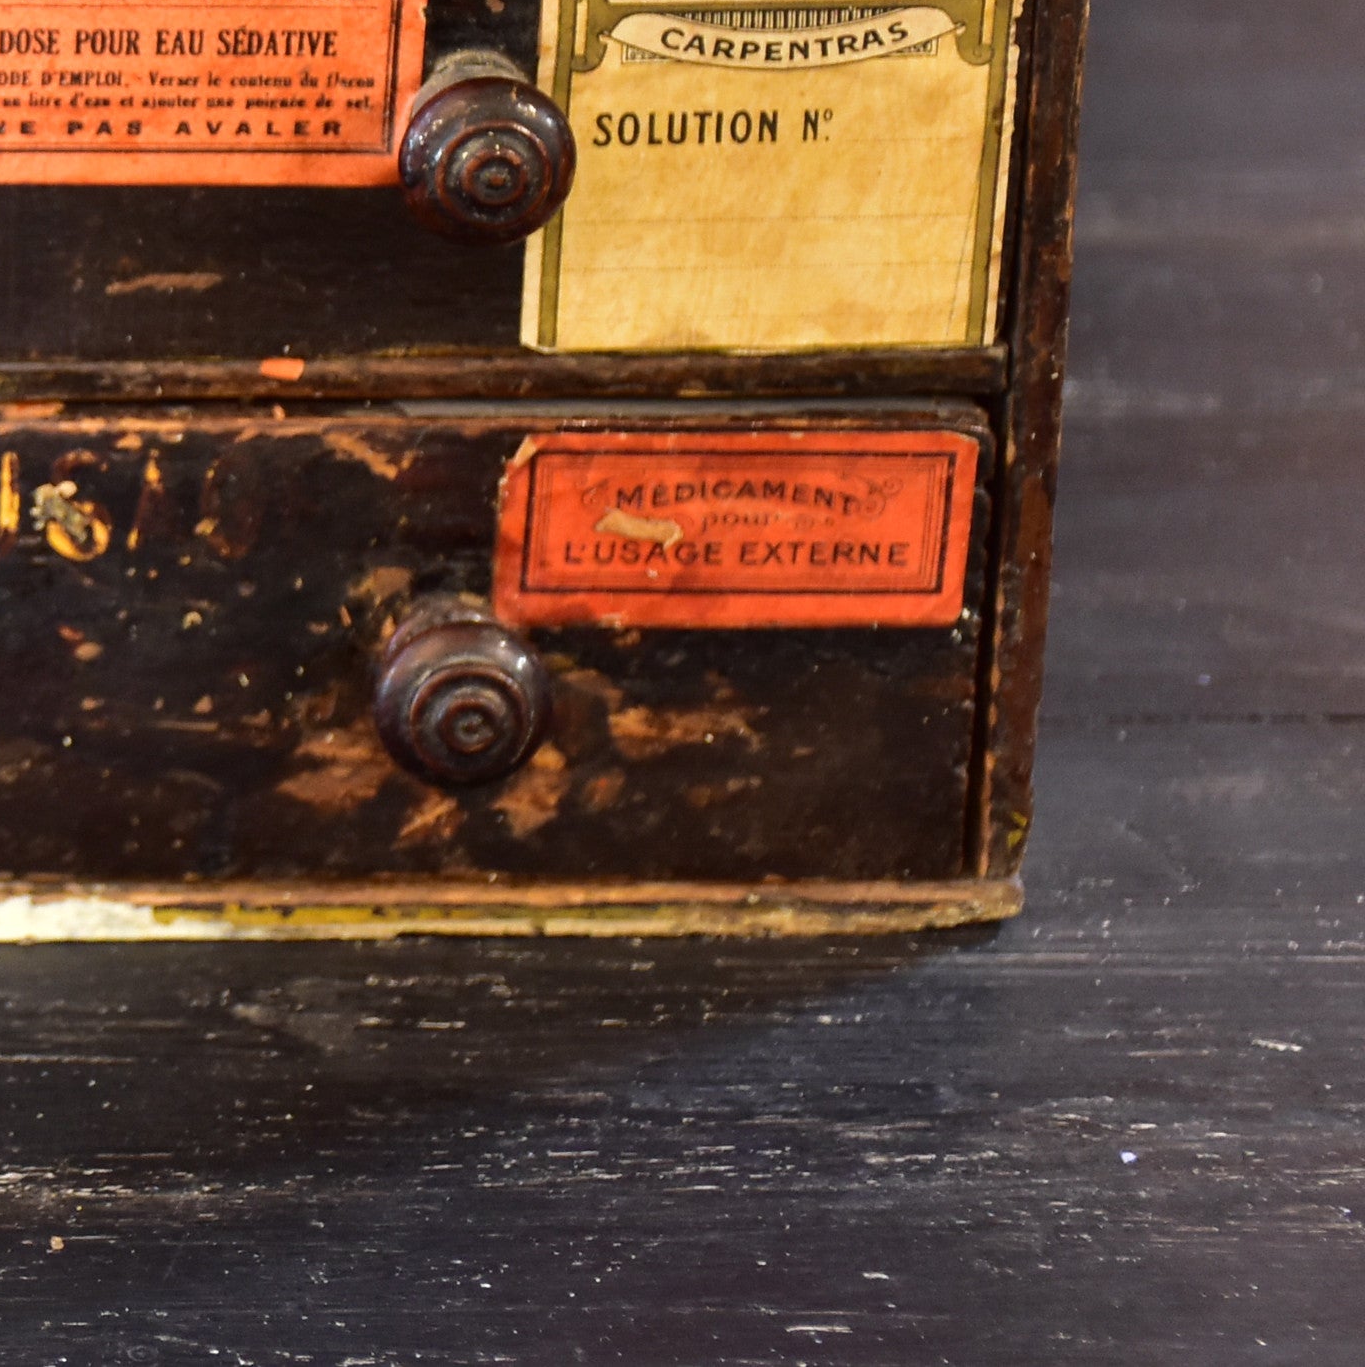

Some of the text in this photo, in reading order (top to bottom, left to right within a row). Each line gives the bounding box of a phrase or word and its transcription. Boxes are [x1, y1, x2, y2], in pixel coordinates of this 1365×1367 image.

[74, 30, 140, 57] POUR
[155, 30, 204, 57] EAU
[216, 24, 338, 58] SÉDATIVE
[660, 21, 909, 63] CARPENTRAS
[149, 70, 200, 87] Verser
[207, 70, 222, 88] le
[230, 71, 293, 88] contenu
[300, 71, 318, 88] du
[2, 96, 21, 108] un
[28, 92, 62, 108] litre
[119, 95, 135, 108] et
[141, 94, 198, 110] ajouter
[206, 96, 235, 108] une
[315, 93, 333, 108] de
[67, 120, 142, 136] PAS
[175, 119, 342, 136] AVALER
[592, 108, 779, 148] SOLUTION
[738, 541, 911, 567] EXTERNE
